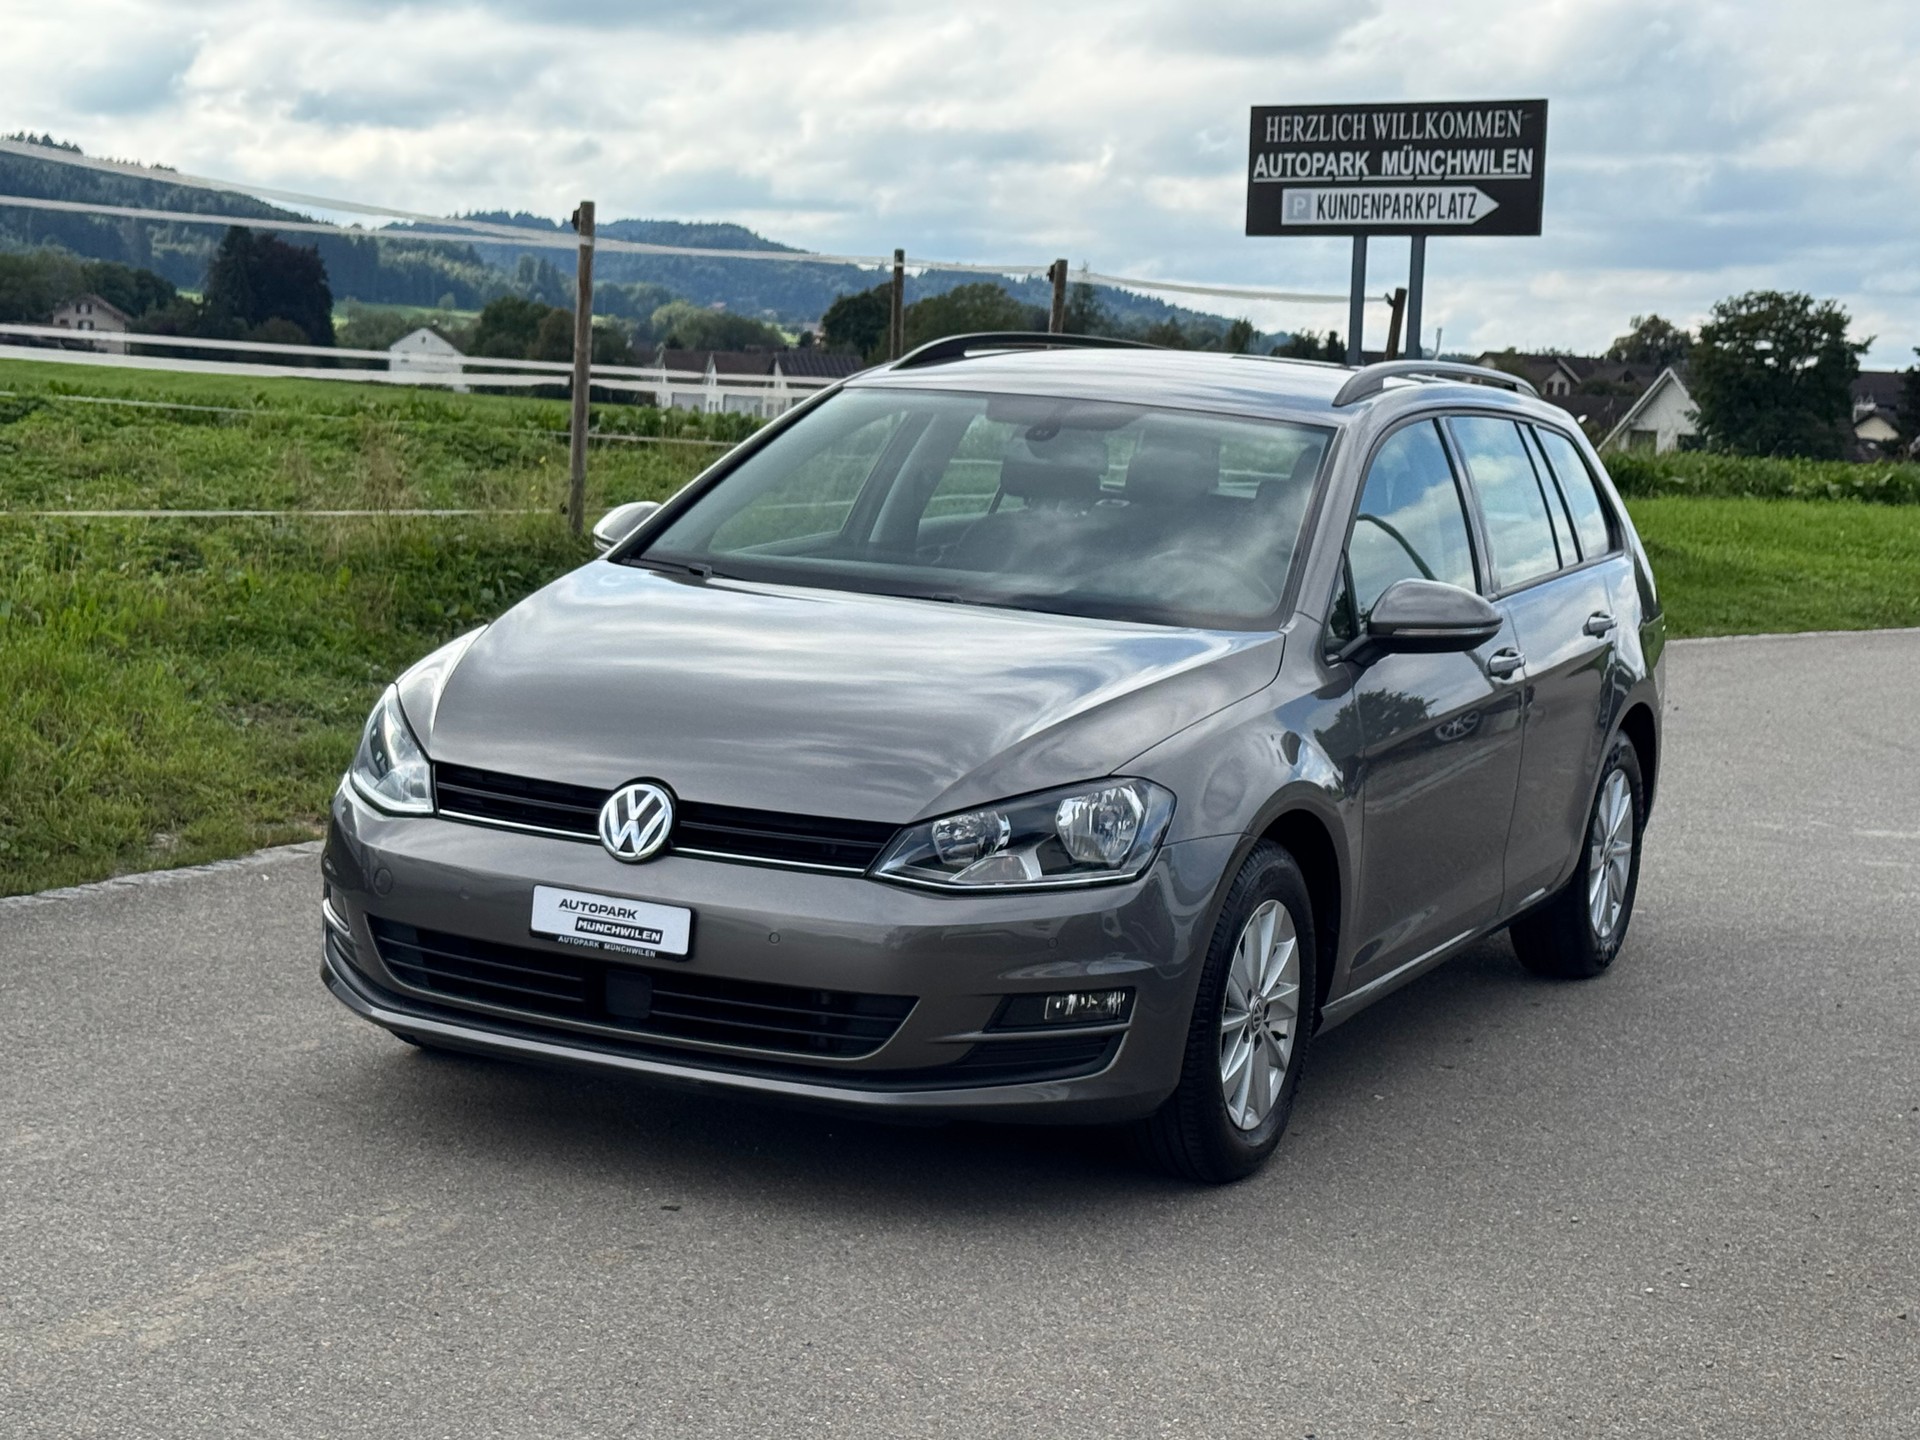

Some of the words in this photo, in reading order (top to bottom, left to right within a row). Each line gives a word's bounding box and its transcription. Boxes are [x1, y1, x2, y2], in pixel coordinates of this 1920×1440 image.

[1265, 112, 1367, 143] HERZLICH
[1372, 109, 1524, 140] WILLKOMMEN
[1253, 150, 1370, 178] AUTOPARK
[1381, 145, 1534, 176] MÜNCHWILEN
[1290, 196, 1307, 217] P
[1316, 192, 1478, 221] KUNDENPARKPLATZ
[601, 784, 672, 857] VW
[558, 898, 639, 920] AUTOPARK
[576, 919, 661, 942] MÜNCHWILEN
[557, 935, 600, 949] AUTOPARK
[603, 943, 657, 958] MÜNCHWILEN
